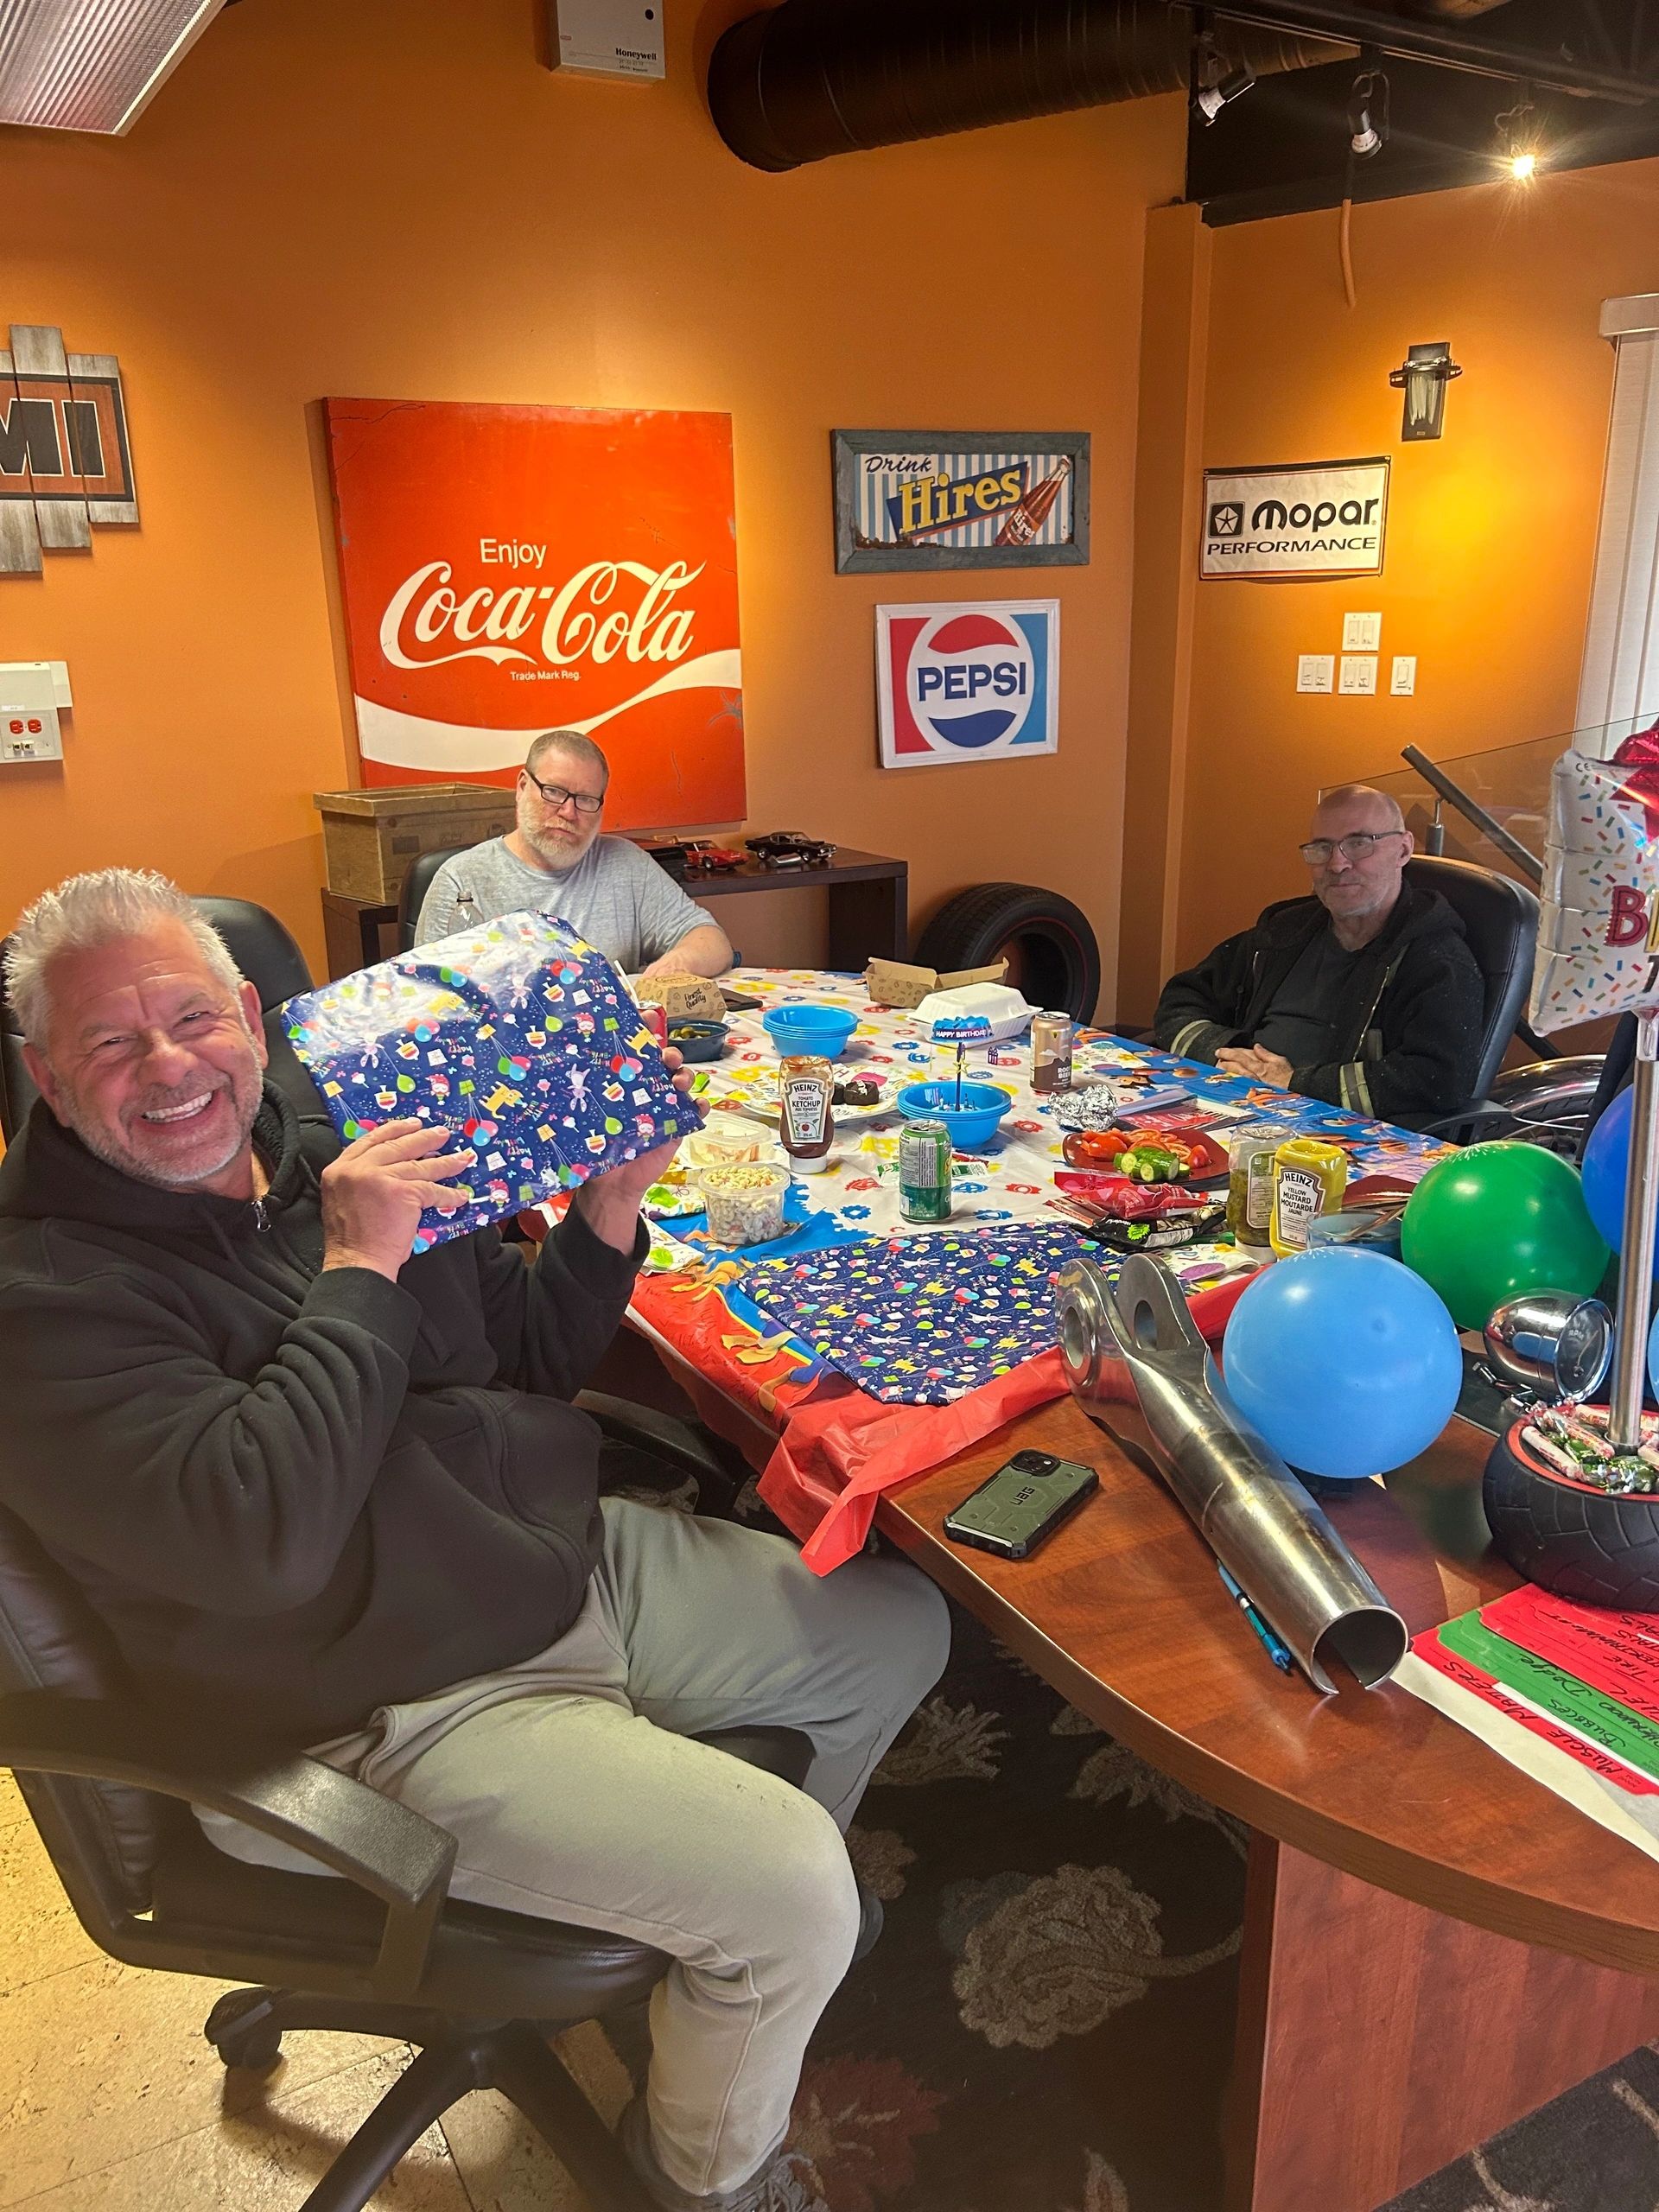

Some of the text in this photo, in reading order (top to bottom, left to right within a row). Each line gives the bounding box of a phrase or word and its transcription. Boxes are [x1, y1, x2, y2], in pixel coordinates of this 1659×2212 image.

[615, 48, 657, 60] Honeywell
[865, 455, 932, 474] Drink
[899, 469, 1021, 534] Hires
[480, 537, 547, 569] Enjoy
[1207, 537, 1377, 556] PERFORMANCE
[379, 560, 707, 670] Coca-Cola
[510, 670, 582, 681] Trade Mark Reg.
[917, 662, 1027, 702] PEPSI
[591, 984, 616, 994] happy
[685, 995, 707, 1010] Quality
[448, 1045, 474, 1054] happy
[793, 1084, 817, 1092] HEINZ
[506, 1146, 533, 1156] happy
[1284, 1173, 1314, 1187] HEINZ
[1282, 1191, 1312, 1205] MUSTARD
[1287, 1186, 1307, 1196] YELLOW
[1281, 1198, 1314, 1212] MOUTARDE
[1287, 1208, 1303, 1217] JAUNE
[1520, 1653, 1592, 1697] Dodge
[1603, 1656, 1647, 1683] TIRE
[1444, 1662, 1621, 1773] MUSCLE MATTERS
